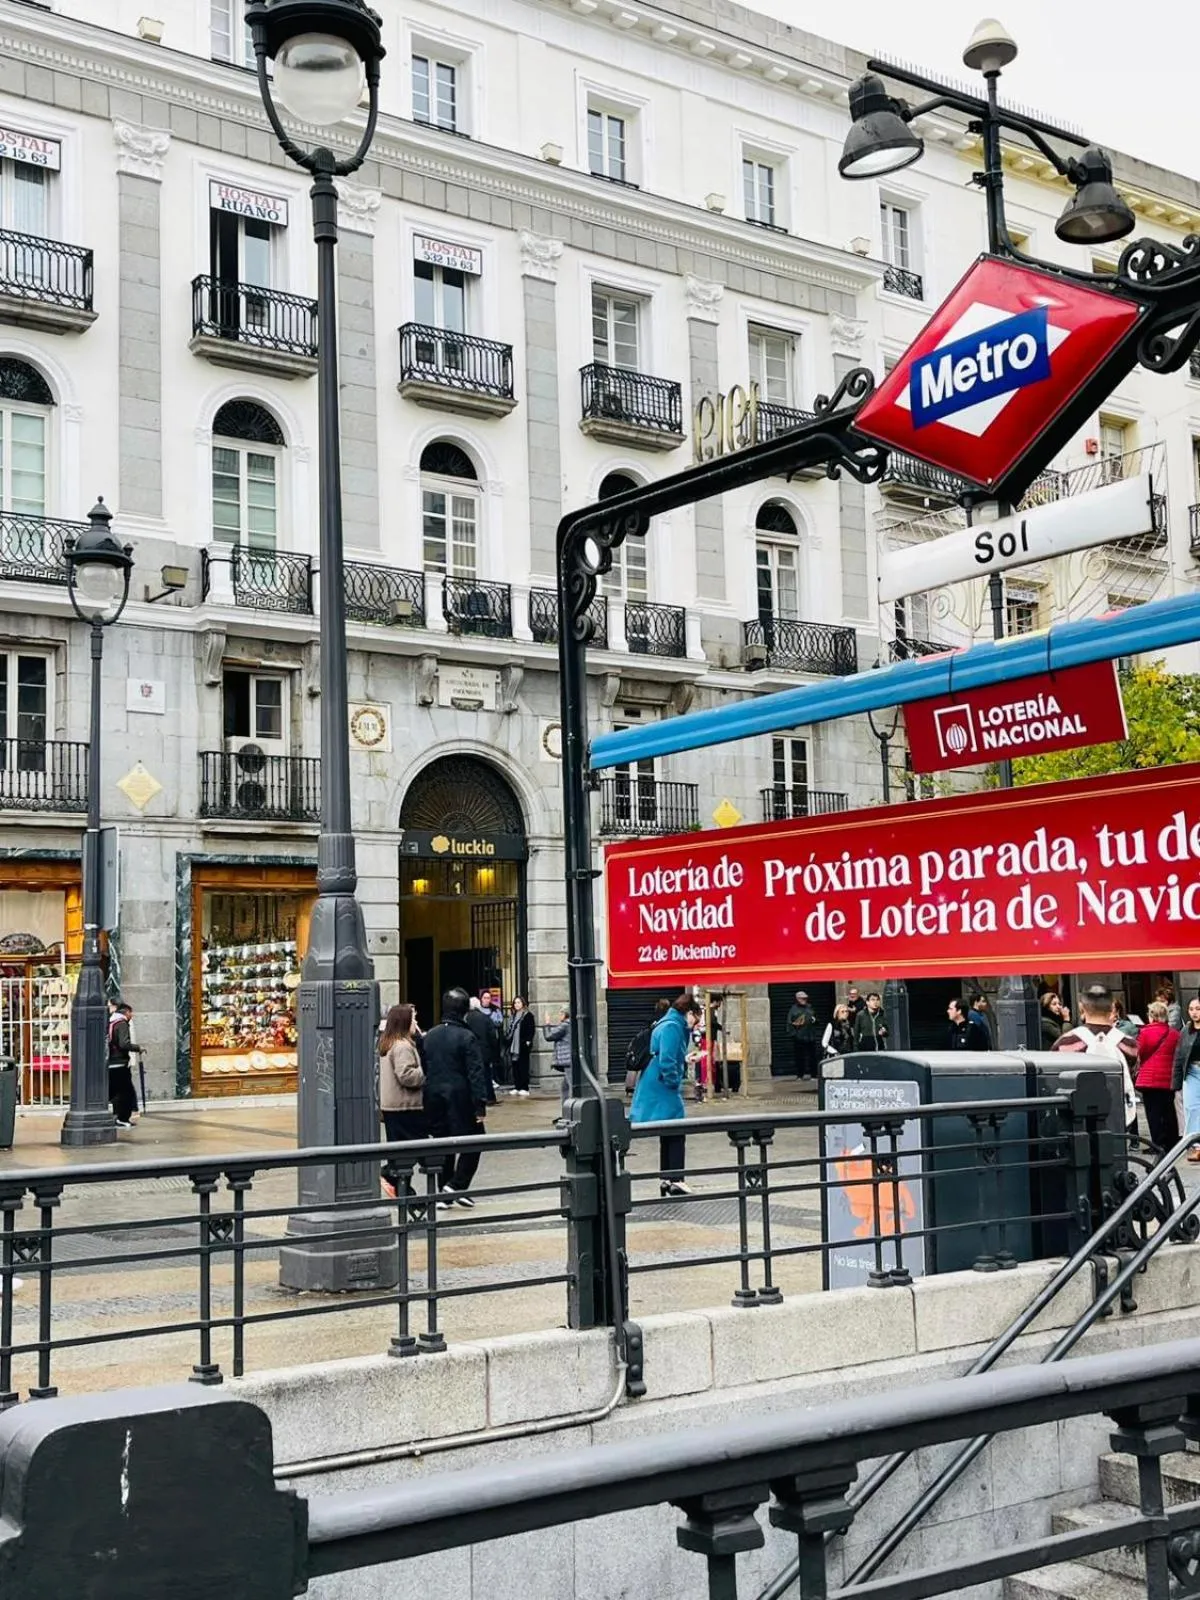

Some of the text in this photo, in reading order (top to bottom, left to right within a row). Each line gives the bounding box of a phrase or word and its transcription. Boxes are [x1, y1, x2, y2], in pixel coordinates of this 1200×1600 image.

[13, 147, 26, 159] 15
[31, 152, 48, 165] 63
[217, 185, 282, 211] HOSTAL
[221, 198, 279, 221] RUANO
[421, 239, 477, 262] HOSTAL
[424, 250, 474, 271] 532 15 63
[920, 333, 1038, 409] Metro
[974, 519, 1029, 564] Sol
[978, 692, 1062, 729] LOTERÍA
[982, 714, 1088, 750] NACIONAL
[451, 838, 495, 855] luckia
[763, 852, 912, 898] Próxima
[919, 827, 1088, 897] parada,
[1096, 823, 1148, 869] tu
[628, 854, 744, 898] Lotería de
[638, 894, 735, 934] Navidad
[804, 901, 846, 943] de
[860, 889, 997, 939] Lotería
[1006, 883, 1058, 931] de
[638, 941, 736, 963] 22 de Diciembre
